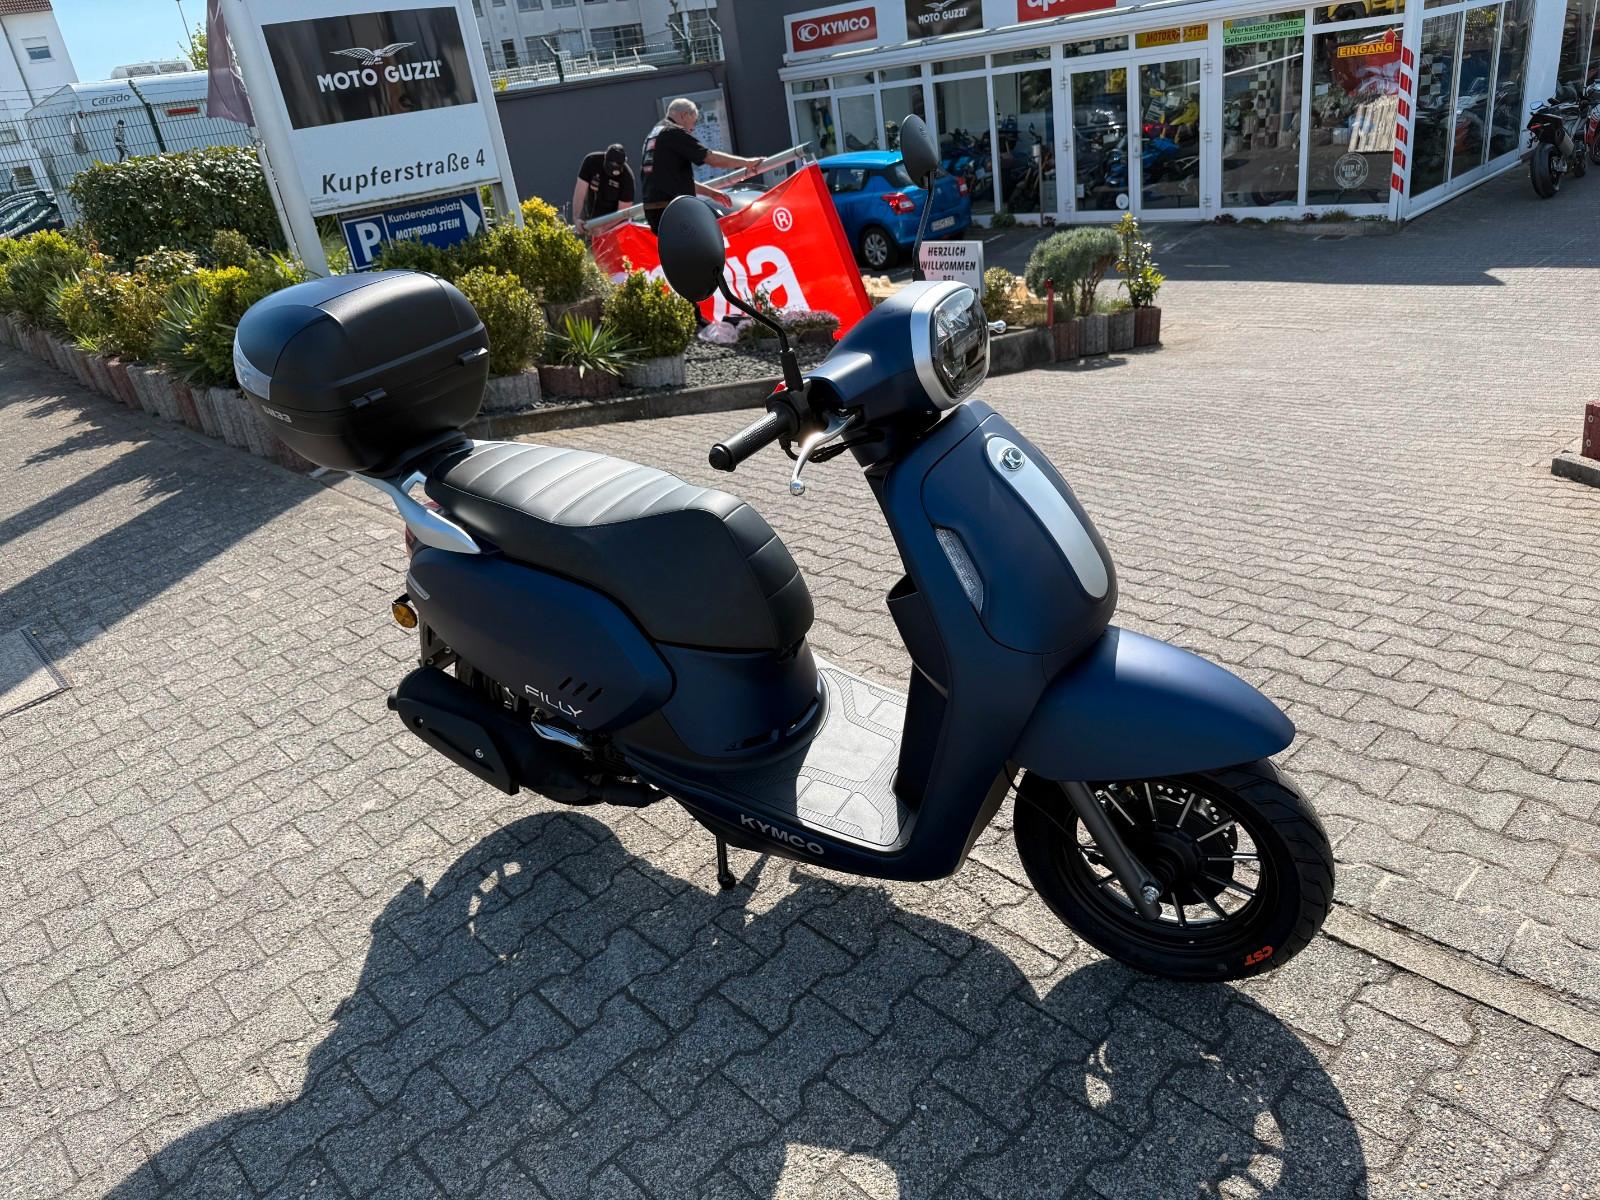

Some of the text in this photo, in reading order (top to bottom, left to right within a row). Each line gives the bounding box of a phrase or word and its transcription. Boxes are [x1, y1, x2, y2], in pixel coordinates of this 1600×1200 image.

[821, 16, 870, 36] KYMCO
[918, 13, 940, 25] MOTO
[1229, 20, 1299, 34] Werkstattgeprüfte
[1224, 28, 1303, 44] Gebrauchtfahrzeuge
[1339, 42, 1393, 57] EINGANG
[316, 68, 378, 93] MOTO
[92, 93, 130, 107] Carado
[322, 148, 486, 195] Kupferstraße 4
[387, 202, 461, 224] Kundenparkplatz
[395, 218, 461, 240] MOTORRAD STEIN
[355, 222, 381, 262] P
[927, 246, 966, 257] HERZLICH
[920, 261, 976, 271] WILLKOMMEN
[525, 684, 583, 718] FILLY
[740, 814, 825, 855] KYMCO
[1244, 945, 1273, 966] CST
